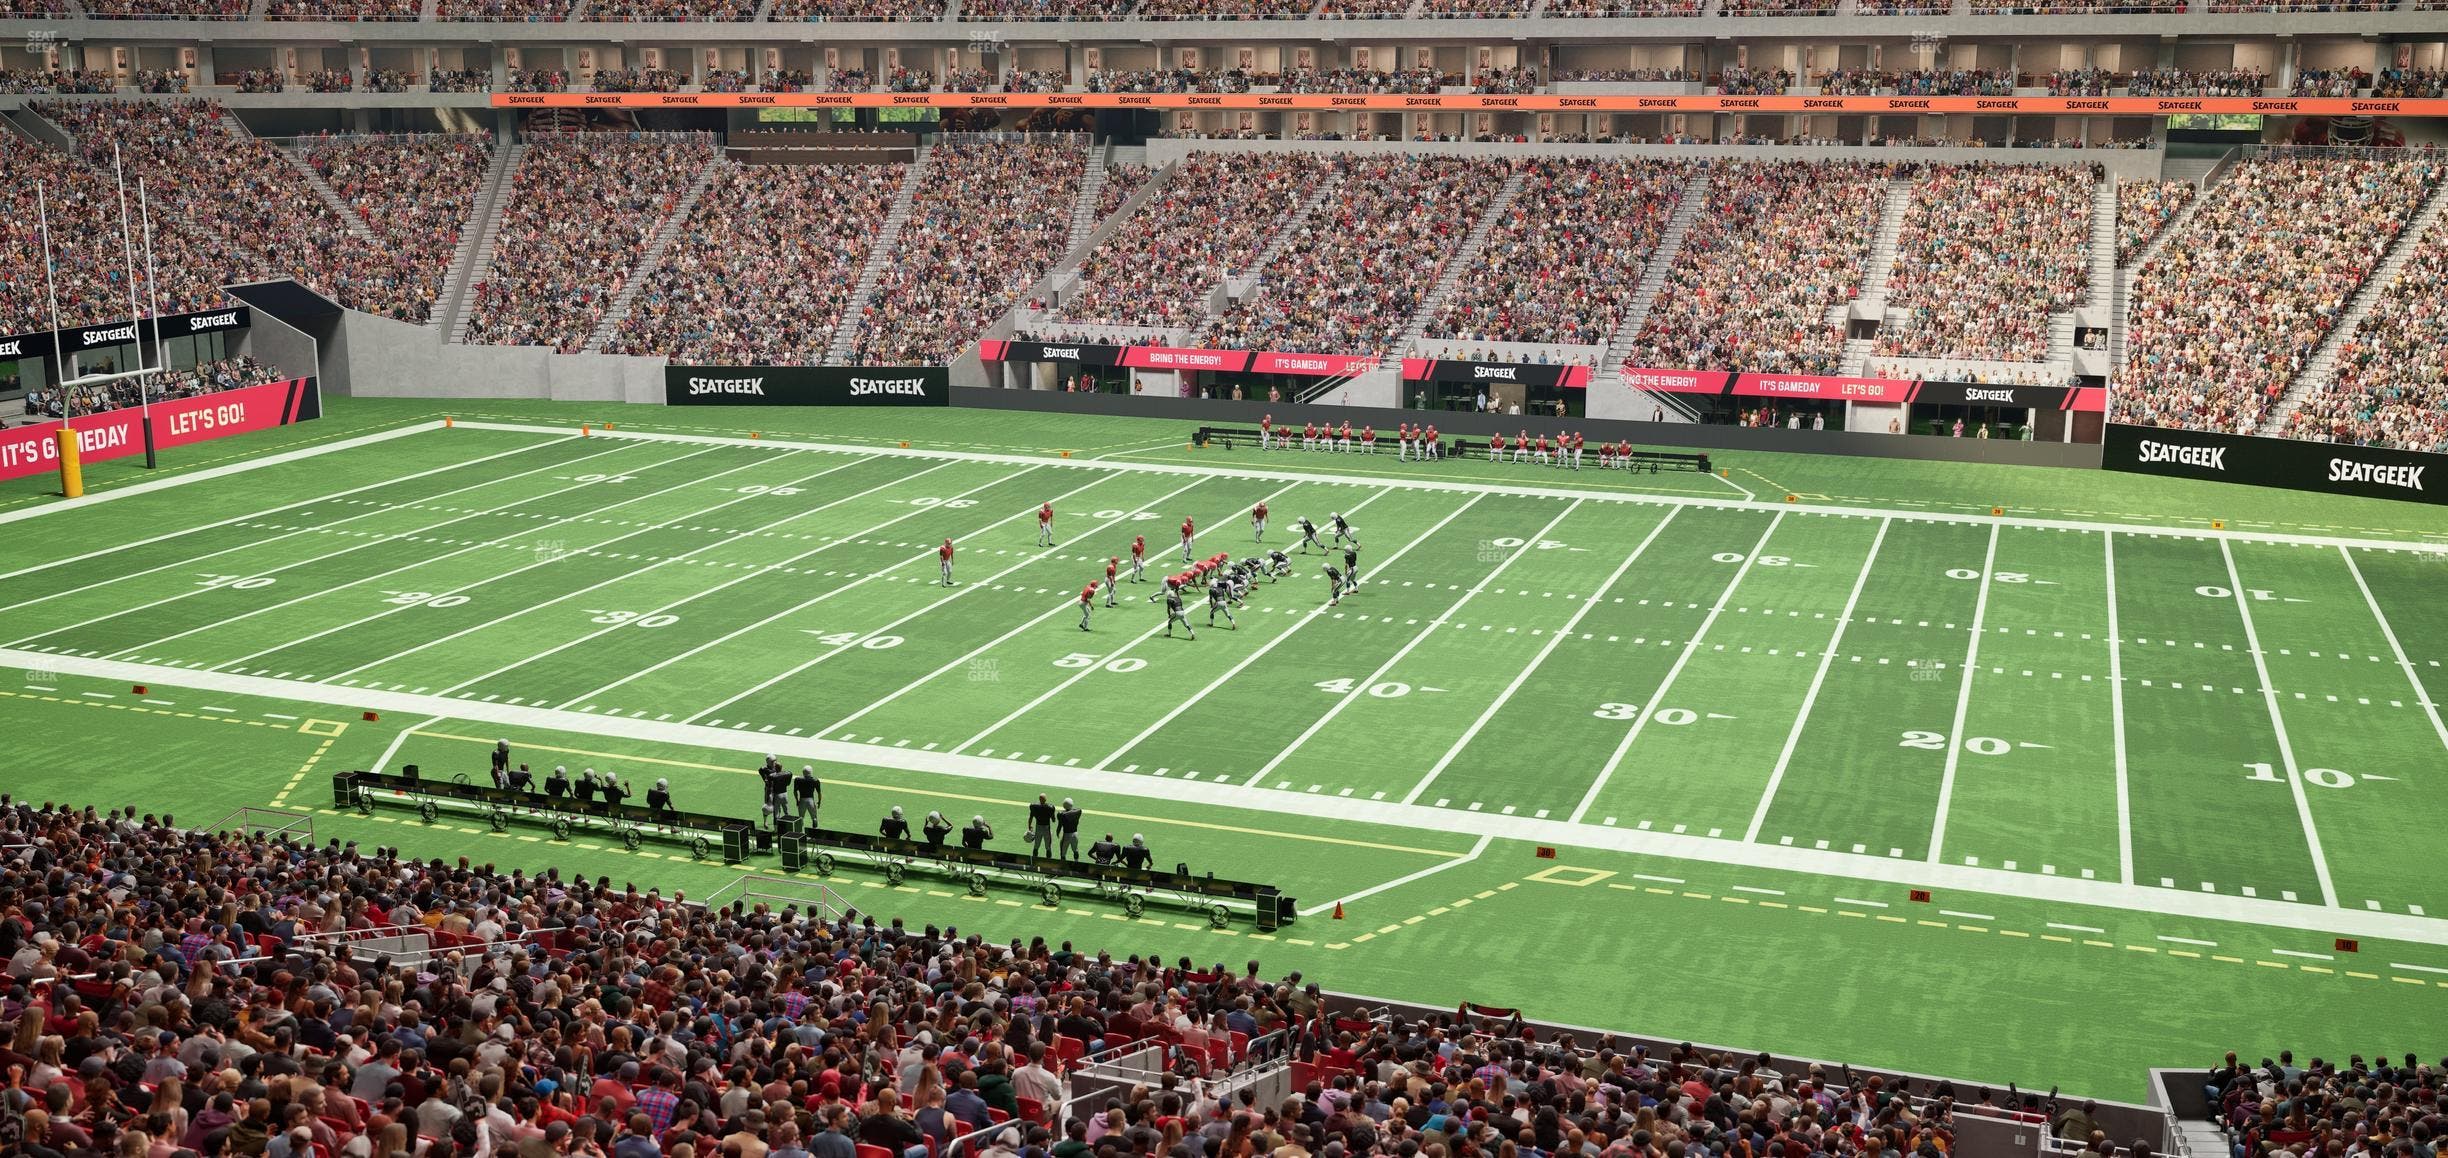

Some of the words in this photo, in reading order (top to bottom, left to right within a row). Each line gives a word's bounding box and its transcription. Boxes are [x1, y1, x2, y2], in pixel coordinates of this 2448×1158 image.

[509, 96, 544, 104] SEATGEEK
[586, 96, 622, 104] SEATGEEK
[663, 96, 698, 104] SEATGEEK
[739, 96, 775, 104] SEATGEEK
[816, 96, 852, 104] SEATGEEK
[894, 96, 929, 104] SEATGEEK
[971, 97, 1007, 105] SEATGEEK
[1048, 97, 1082, 105] SEATGEEK
[1119, 97, 1151, 105] SEATGEEK
[1188, 97, 1221, 105] SEATGEEK
[1259, 97, 1293, 106] SEATGEEK
[1332, 98, 1366, 106] SEATGEEK
[1406, 98, 1441, 107] SEATGEEK
[1482, 98, 1518, 107] SEATGEEK
[1560, 99, 1596, 107] SEATGEEK
[1639, 99, 1677, 108] SEATGEEK
[1720, 99, 1759, 108] SEATGEEK
[1804, 100, 1843, 109] SEATGEEK
[1889, 100, 1930, 109] SEATGEEK
[1976, 100, 2018, 110] SEATGEEK
[2066, 101, 2109, 111] SEATGEEK
[2158, 101, 2202, 111] SEATGEEK
[2252, 102, 2298, 112] SEATGEEK
[2351, 102, 2400, 112] SEATGEEK
[191, 312, 237, 330] SEATGEEK
[83, 325, 135, 345] SEATGEEK
[1043, 347, 1080, 360] SEATGEEK
[1150, 353, 1173, 364] BRING
[1175, 353, 1187, 365] THE
[1189, 354, 1222, 366] ENERGY!
[1275, 358, 1290, 369] IT'S
[1291, 359, 1328, 370] GAMEDAY
[1474, 366, 1516, 380] SEATGEEK
[689, 377, 764, 395] SEATGEEK
[1642, 375, 1659, 385] THE
[1661, 376, 1697, 387] ENERGY!
[850, 377, 925, 396] SEATGEEK
[1759, 380, 1776, 391] IT'S
[1778, 382, 1821, 393] GAMEDAY
[1842, 384, 1865, 395] LET'S
[1966, 388, 2014, 403] SEATGEEK
[170, 409, 214, 435] LET'S
[218, 402, 245, 426] GO!
[1, 440, 39, 467] IT'S
[42, 423, 128, 459] GMEDAY
[2139, 440, 2226, 470] SEATGEEK
[2328, 458, 2425, 490] SEATGEEK
[1052, 653, 1148, 673] 50
[1313, 677, 1411, 698] 40
[1593, 703, 1697, 725] 30
[1899, 731, 2011, 755] 20
[2243, 762, 2355, 788] 10
